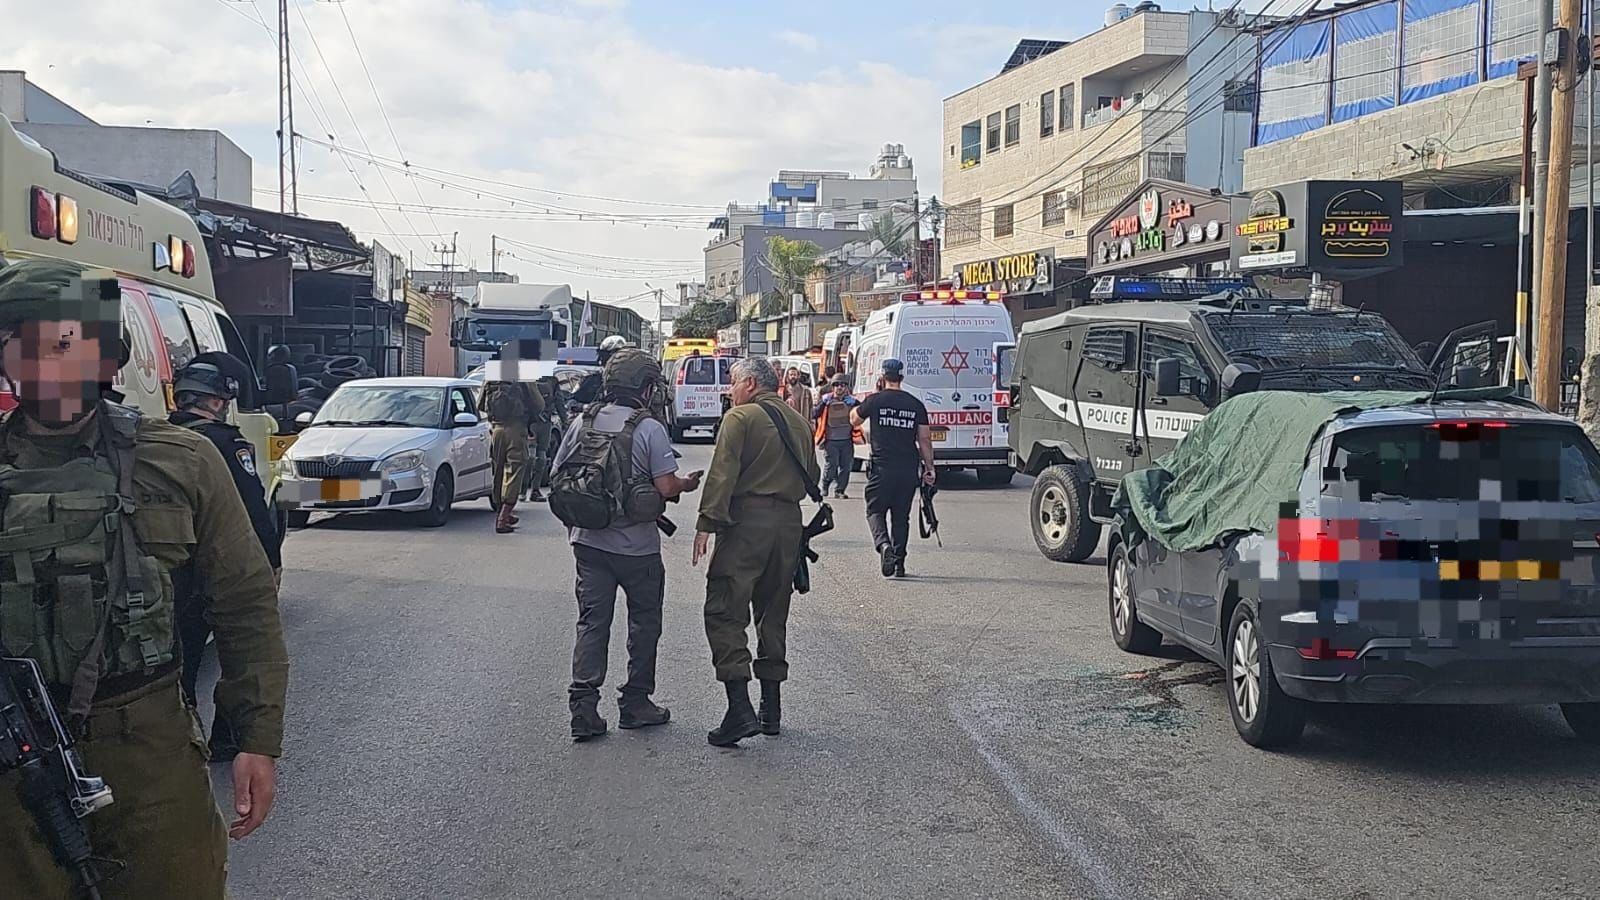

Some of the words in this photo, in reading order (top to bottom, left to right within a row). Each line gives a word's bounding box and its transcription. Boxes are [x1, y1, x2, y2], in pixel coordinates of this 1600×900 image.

[87, 208, 126, 247] הרפואה
[128, 215, 144, 252] חיל
[1110, 215, 1139, 238] מאפיה
[963, 261, 993, 286] MEGA
[997, 252, 1036, 281] STORE
[879, 417, 915, 429] אבטחה
[928, 412, 991, 424] MBULANC
[1087, 407, 1128, 425] POLICE
[1096, 456, 1122, 471] הגבול
